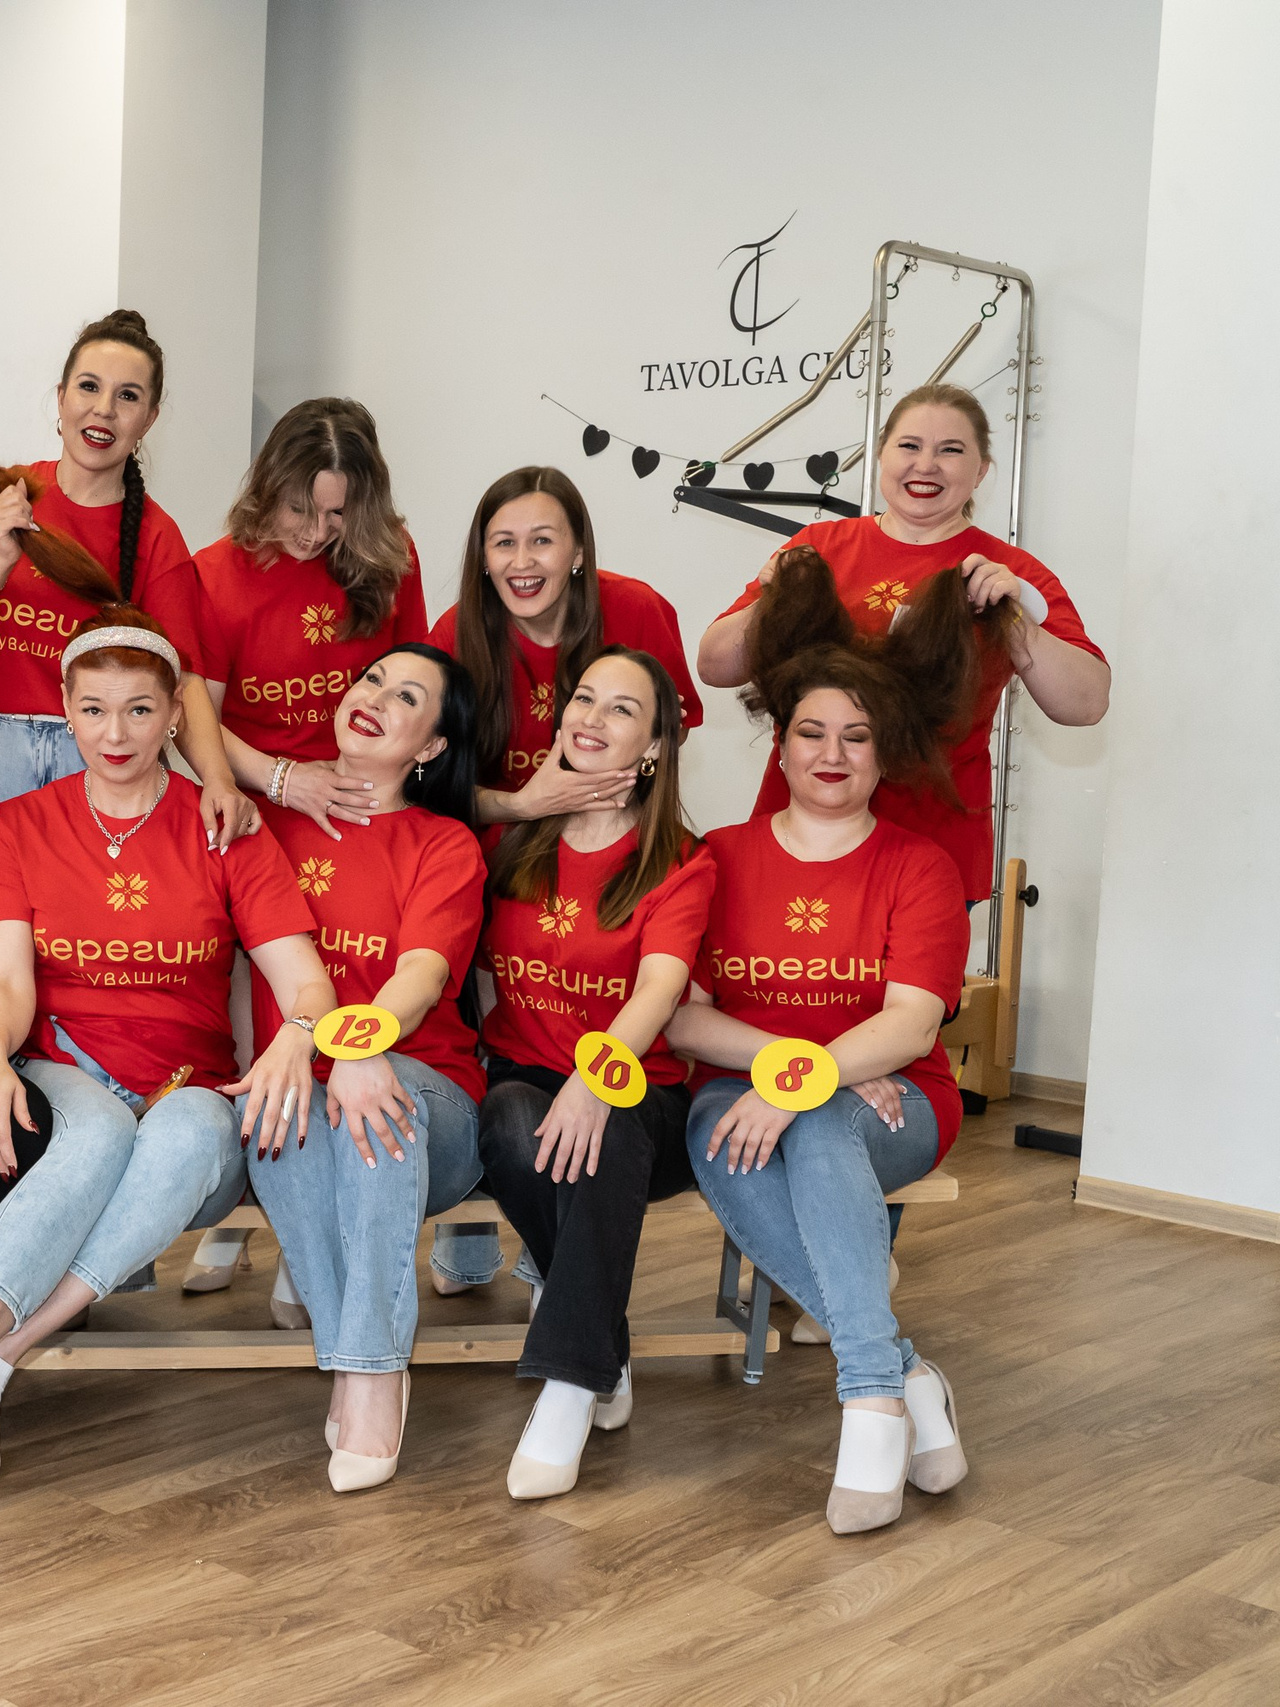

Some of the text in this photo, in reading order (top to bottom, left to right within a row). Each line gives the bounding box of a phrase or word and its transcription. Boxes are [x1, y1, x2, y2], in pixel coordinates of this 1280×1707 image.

[640, 355, 788, 392] TAVOLGA
[743, 990, 861, 1006] чувашии
[330, 1014, 381, 1049] 12
[587, 1043, 632, 1091] 10
[775, 1057, 814, 1092] 8
